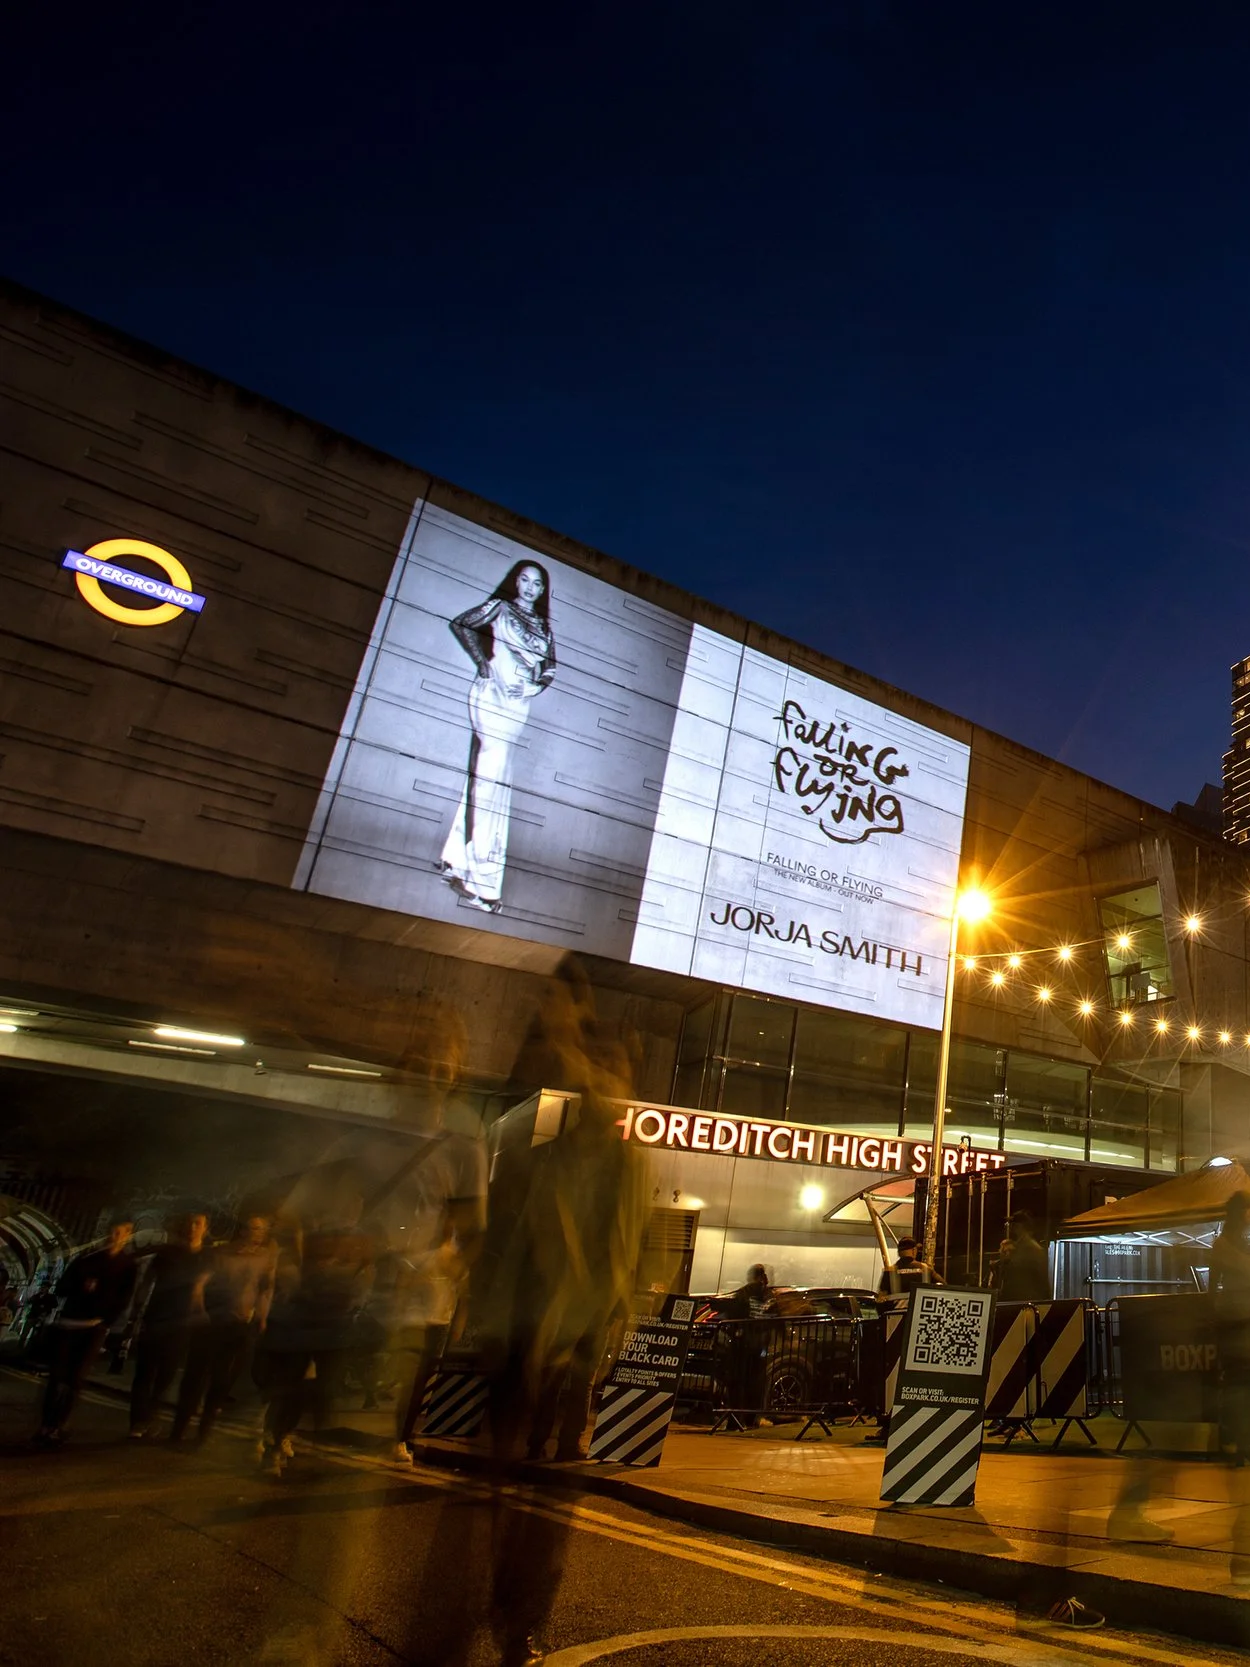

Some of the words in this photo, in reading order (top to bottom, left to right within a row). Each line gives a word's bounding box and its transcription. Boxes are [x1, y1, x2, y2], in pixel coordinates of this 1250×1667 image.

[76, 558, 193, 606] OVERGROUND
[767, 852, 817, 877] FALLING
[820, 870, 838, 884] OR
[842, 876, 883, 897] FLYING
[774, 868, 788, 879] THE
[788, 873, 805, 884] NEW
[807, 880, 832, 893] ALBUM
[838, 889, 853, 899] OUT
[855, 893, 874, 904] NOW
[710, 903, 812, 948] JORJA
[820, 930, 922, 976] SMITH
[826, 1134, 903, 1171] HIGH
[911, 1144, 1006, 1176] SREET
[622, 1341, 648, 1353] YOUR
[623, 1331, 679, 1346] DOWNLOAD
[618, 1351, 650, 1363] BLACK
[651, 1354, 680, 1367] CARD
[1160, 1344, 1218, 1371] BOXP
[902, 1386, 918, 1394] SCAN
[918, 1387, 928, 1395] OR
